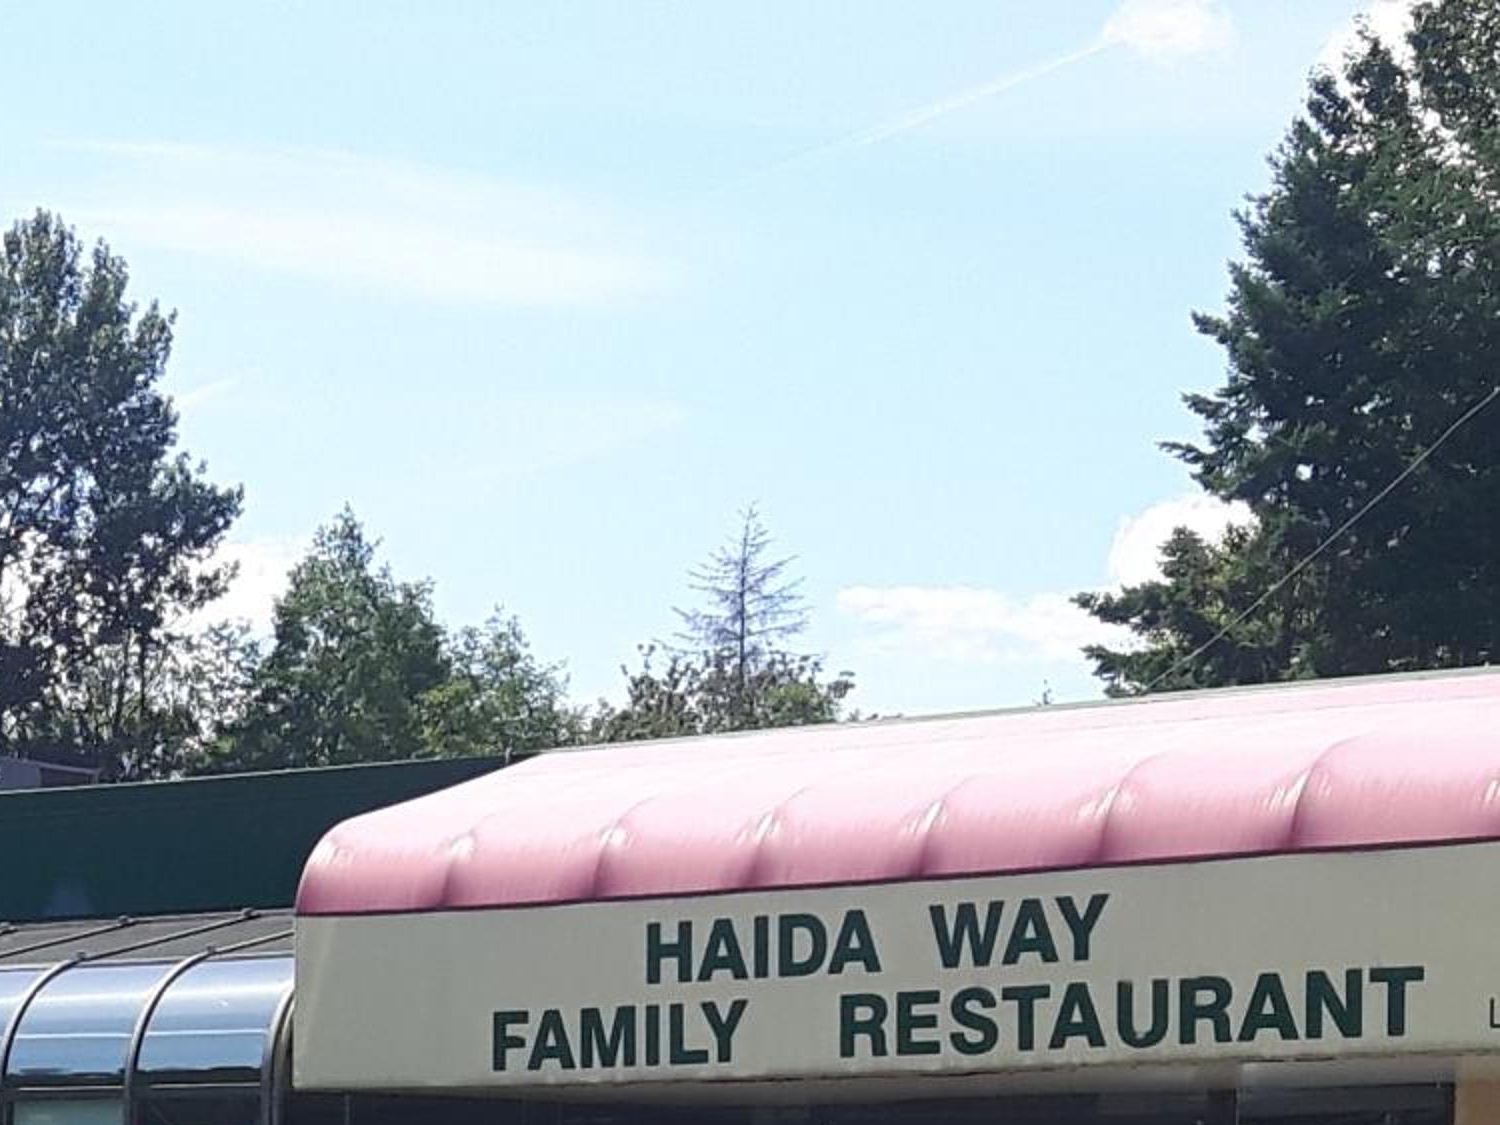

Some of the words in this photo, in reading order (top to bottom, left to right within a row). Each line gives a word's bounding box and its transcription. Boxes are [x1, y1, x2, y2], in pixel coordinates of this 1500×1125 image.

[646, 909, 882, 985] HAIDA
[928, 893, 1109, 969] WAY
[492, 1002, 749, 1072] FAMILY
[839, 965, 1425, 1059] RESTAURANT
